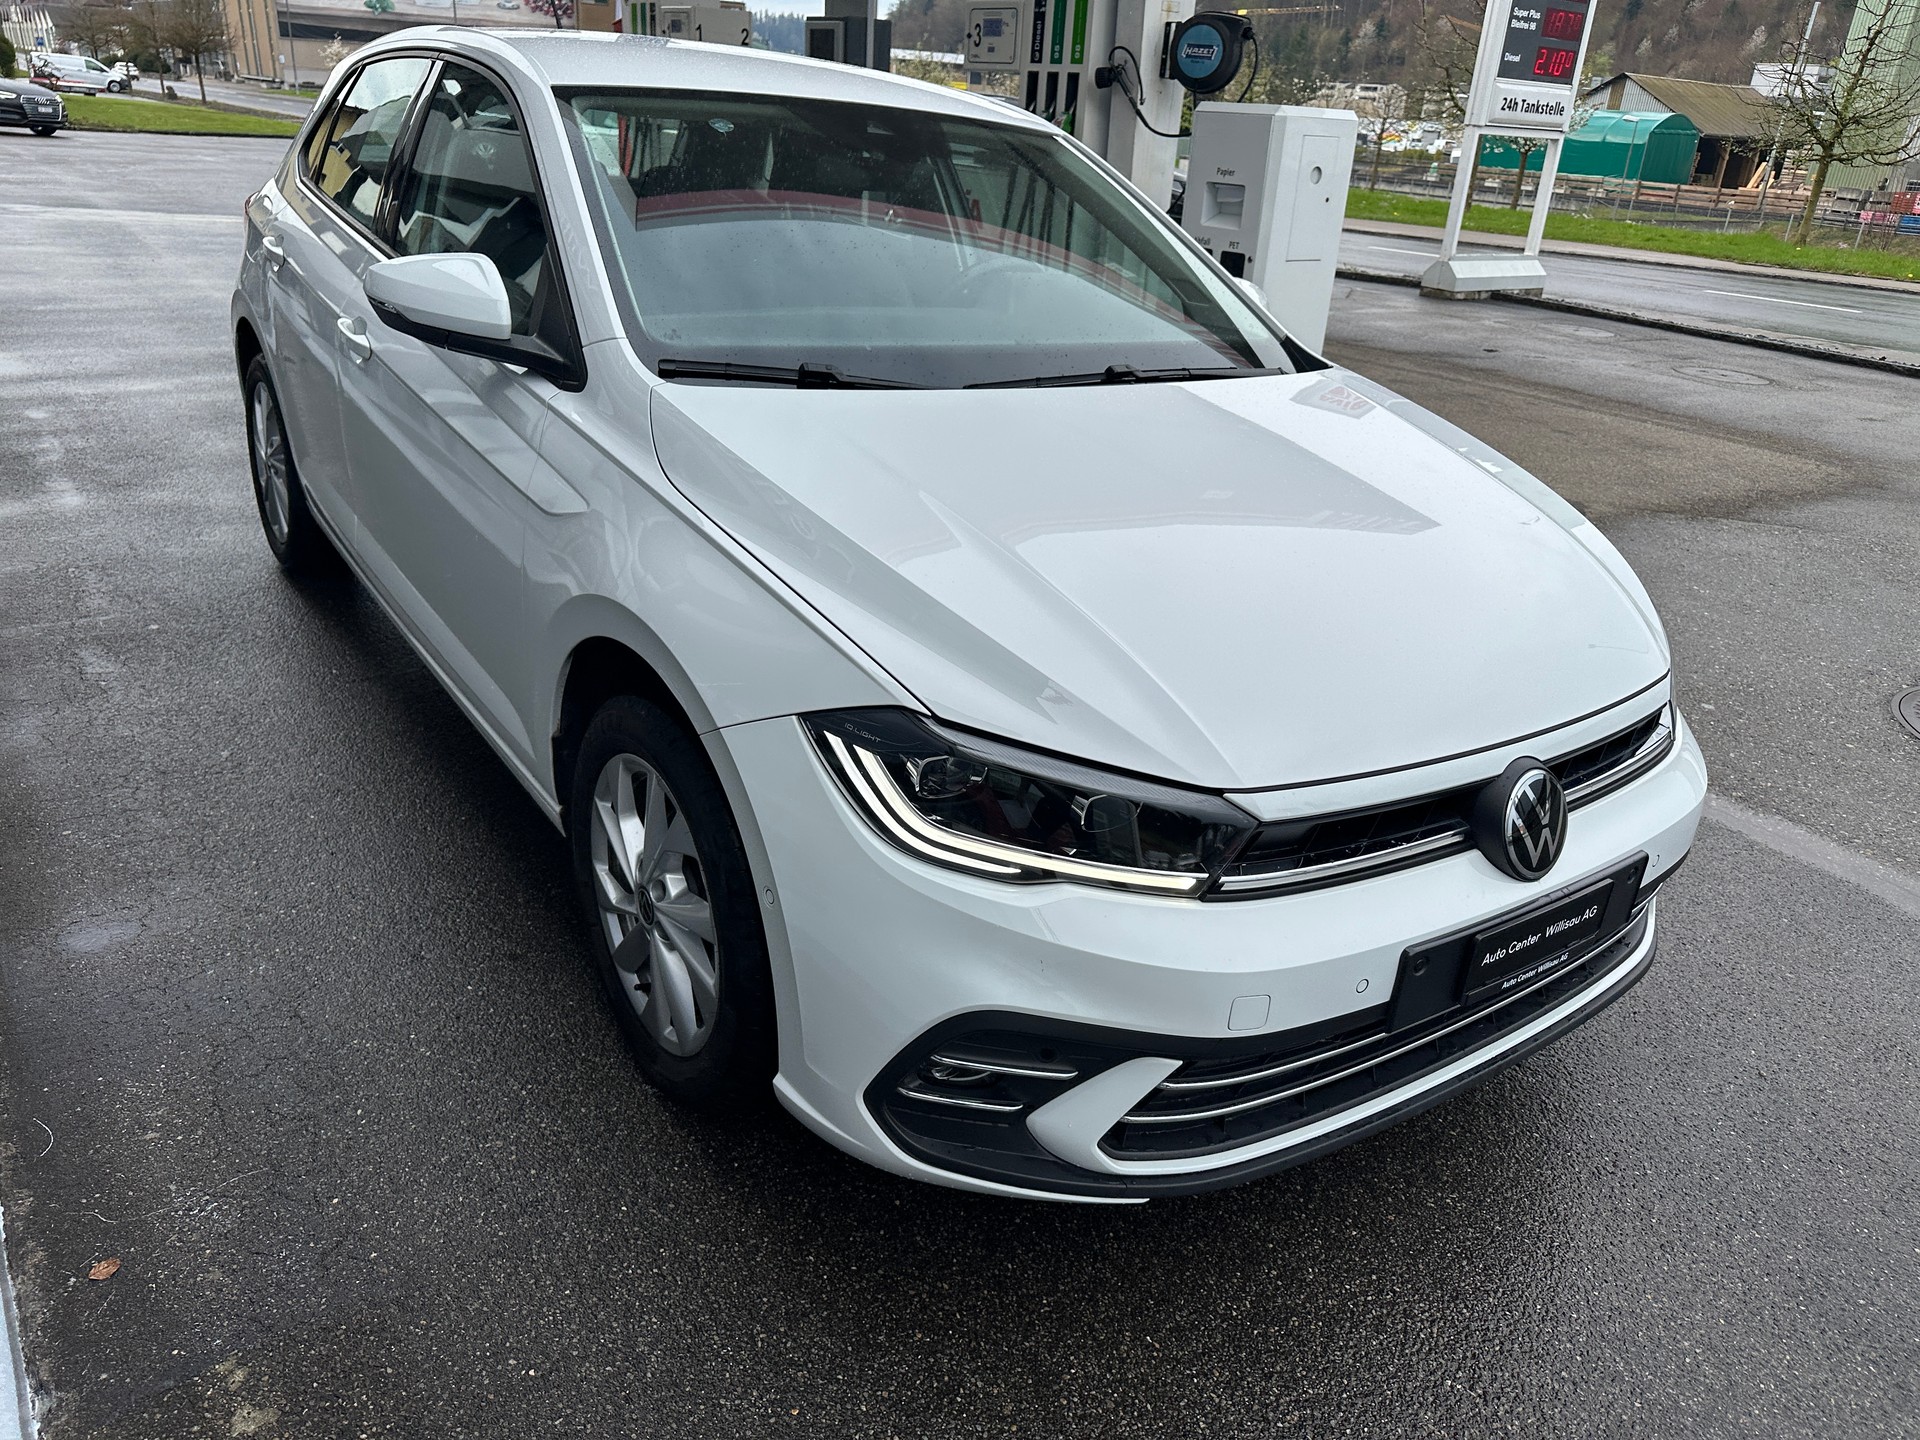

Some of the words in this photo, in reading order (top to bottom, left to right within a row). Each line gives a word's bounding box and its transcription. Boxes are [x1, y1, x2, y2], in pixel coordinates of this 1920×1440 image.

[1512, 7, 1529, 19] Super
[1529, 9, 1541, 19] Plus
[695, 23, 702, 41] 1
[1510, 19, 1530, 29] Bleifrei
[1529, 22, 1537, 31] 98
[741, 28, 749, 46] 2
[973, 23, 981, 47] 3
[1504, 52, 1521, 62] Diesel
[1501, 97, 1519, 112] 24h
[1520, 99, 1565, 116] Tankstelle
[1216, 167, 1236, 178] Papier
[1228, 241, 1240, 250] PET
[1481, 947, 1507, 967] Auto
[1508, 932, 1542, 954] Center
[1545, 914, 1581, 938] Willisau
[1581, 905, 1598, 922] AG
[1502, 977, 1517, 989] Auto
[1517, 968, 1537, 982] Center
[1537, 957, 1559, 975] Willisau
[1559, 952, 1569, 963] AG
